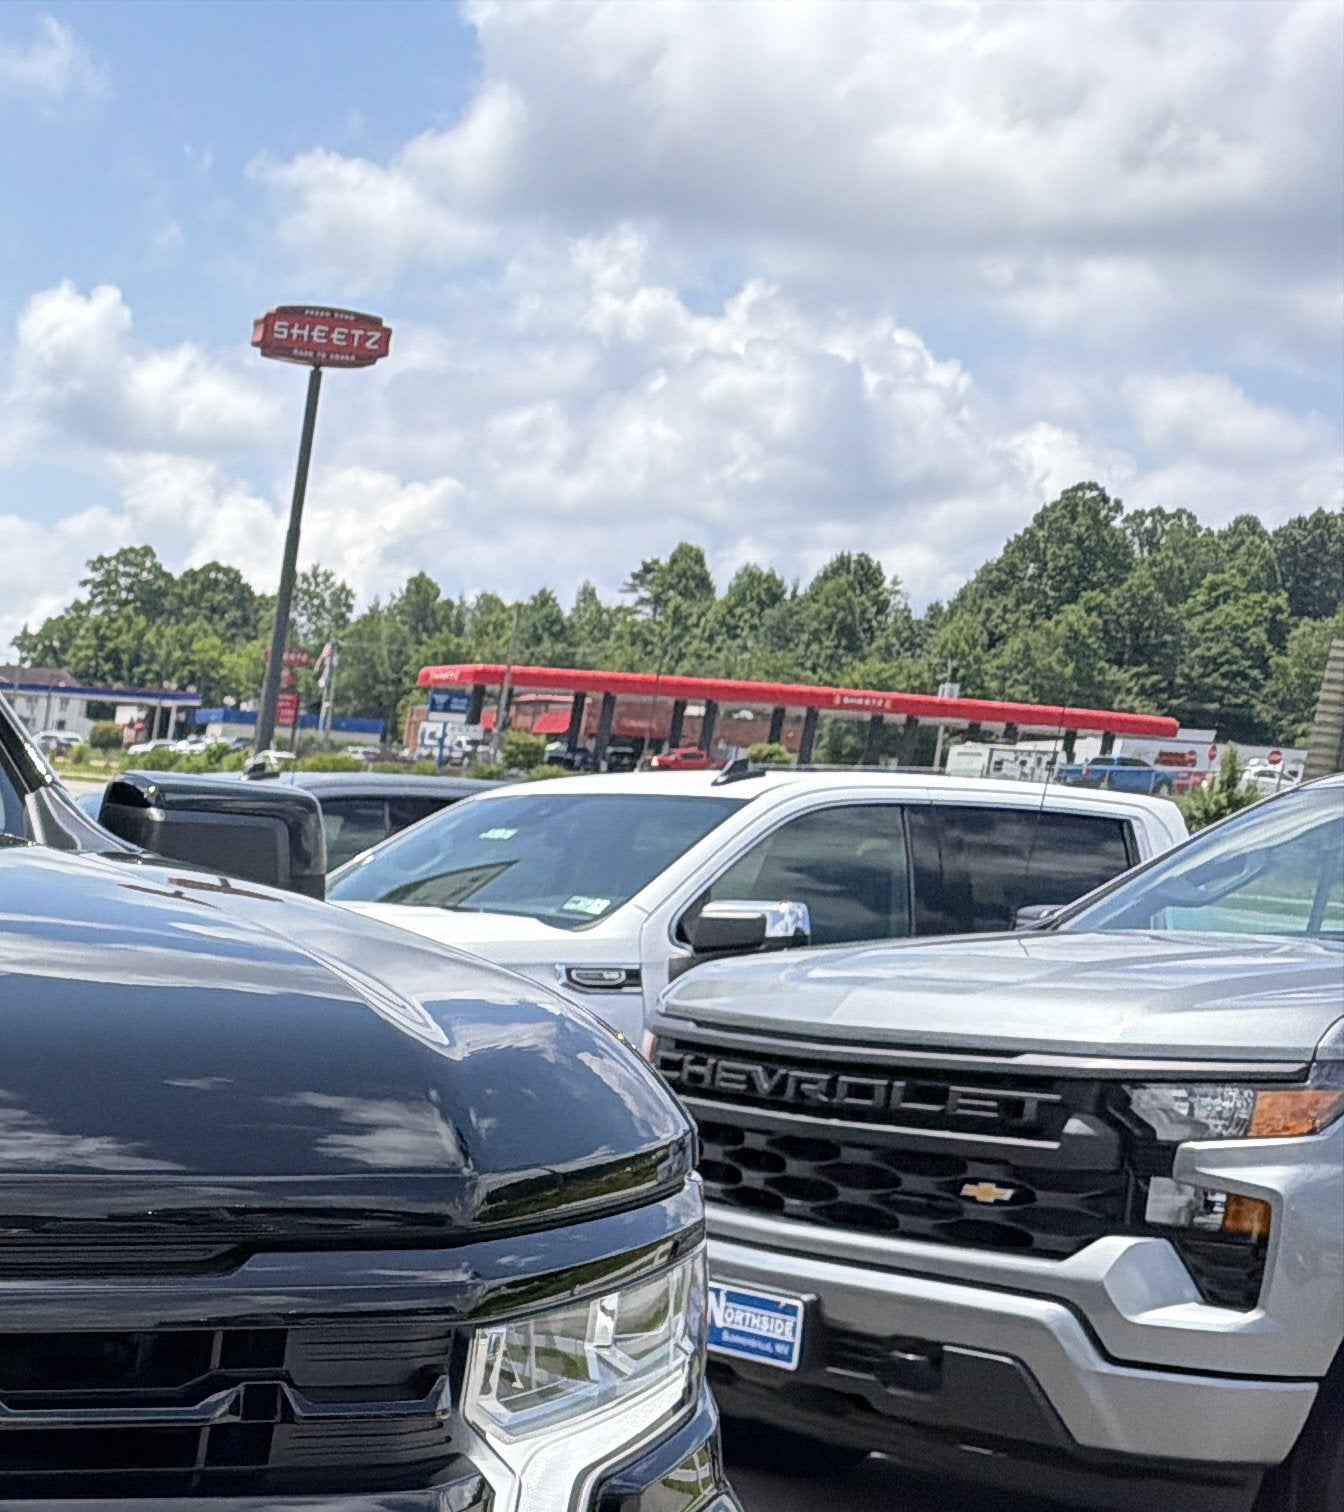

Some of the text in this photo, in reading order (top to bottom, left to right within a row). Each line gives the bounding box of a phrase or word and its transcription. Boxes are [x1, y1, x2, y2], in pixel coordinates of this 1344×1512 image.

[273, 320, 382, 350] SHEETZ
[655, 1050, 1061, 1121] CHEVROLET
[708, 1288, 794, 1337] NORTHSIDE
